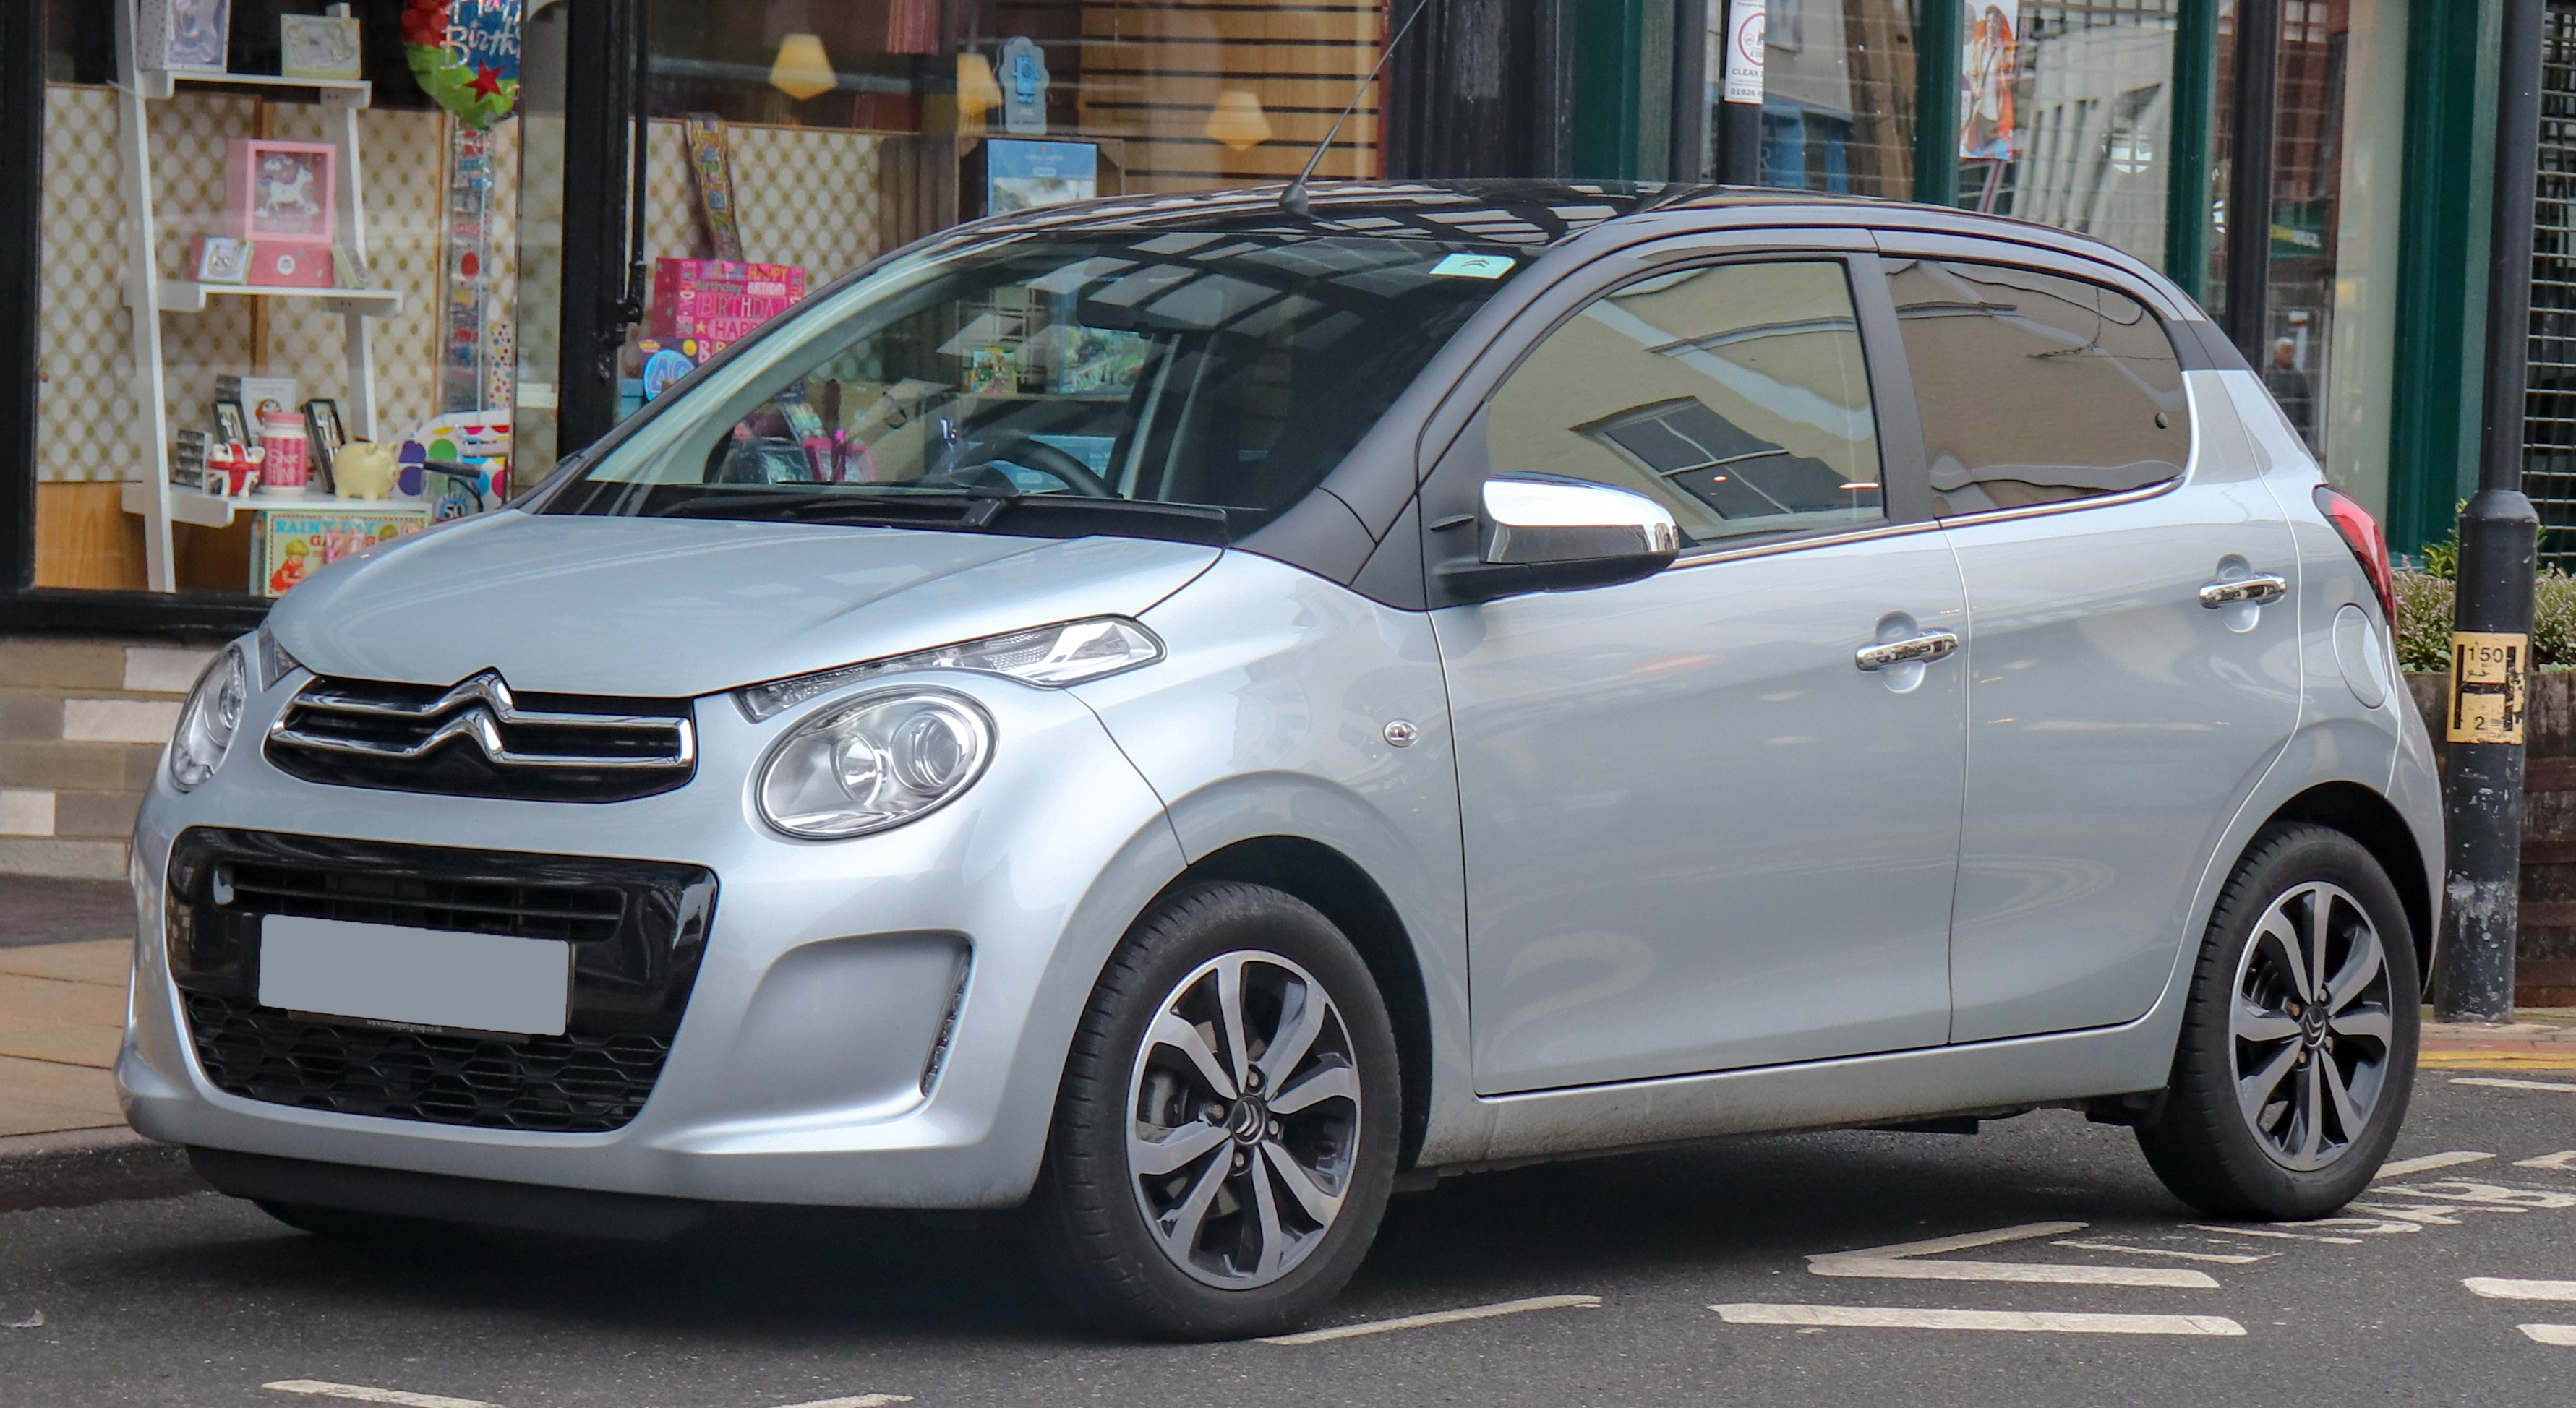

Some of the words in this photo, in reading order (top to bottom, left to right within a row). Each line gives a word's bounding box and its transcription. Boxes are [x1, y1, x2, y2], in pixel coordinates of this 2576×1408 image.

[438, 18, 521, 70] Birth
[1732, 67, 1759, 77] CLEAN
[2468, 646, 2504, 664] 150
[2475, 716, 2486, 731] 2
